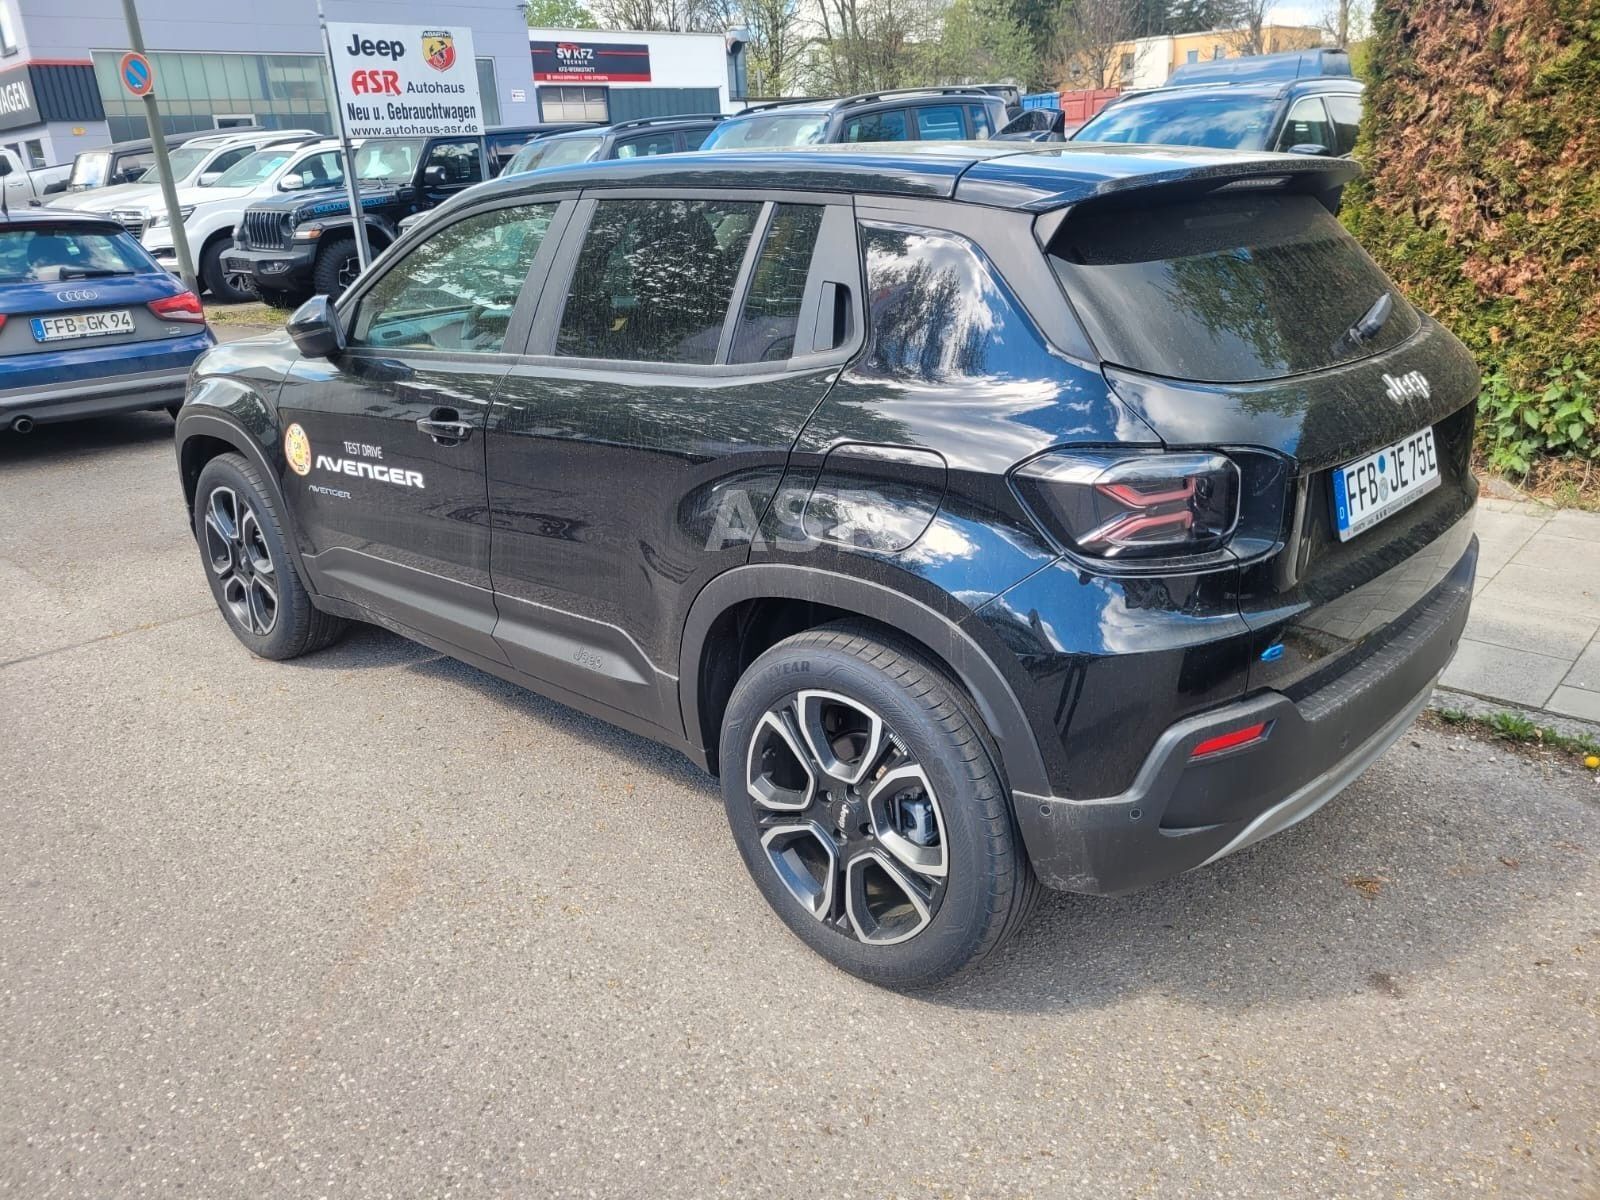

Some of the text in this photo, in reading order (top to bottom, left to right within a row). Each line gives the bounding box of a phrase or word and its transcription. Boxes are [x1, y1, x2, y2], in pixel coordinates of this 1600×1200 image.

[347, 34, 405, 61] Jeep
[556, 48, 594, 59] SV KFZ
[351, 70, 465, 96] ASR Autohaus
[0, 81, 30, 115] AGEN
[347, 103, 476, 123] Neu u. Gebrauchtwagen
[351, 123, 478, 136] www.autohaus-asr.de
[43, 318, 77, 336] FFB
[86, 314, 110, 332] GK
[110, 313, 131, 328] 94
[1381, 370, 1430, 405] Jeep
[343, 441, 383, 460] TEST DRIVE
[315, 455, 426, 489] AVENGER
[1346, 462, 1379, 517] FFB
[1390, 446, 1409, 493] JE
[1408, 431, 1436, 482] 75E
[308, 484, 352, 499] AVENGER
